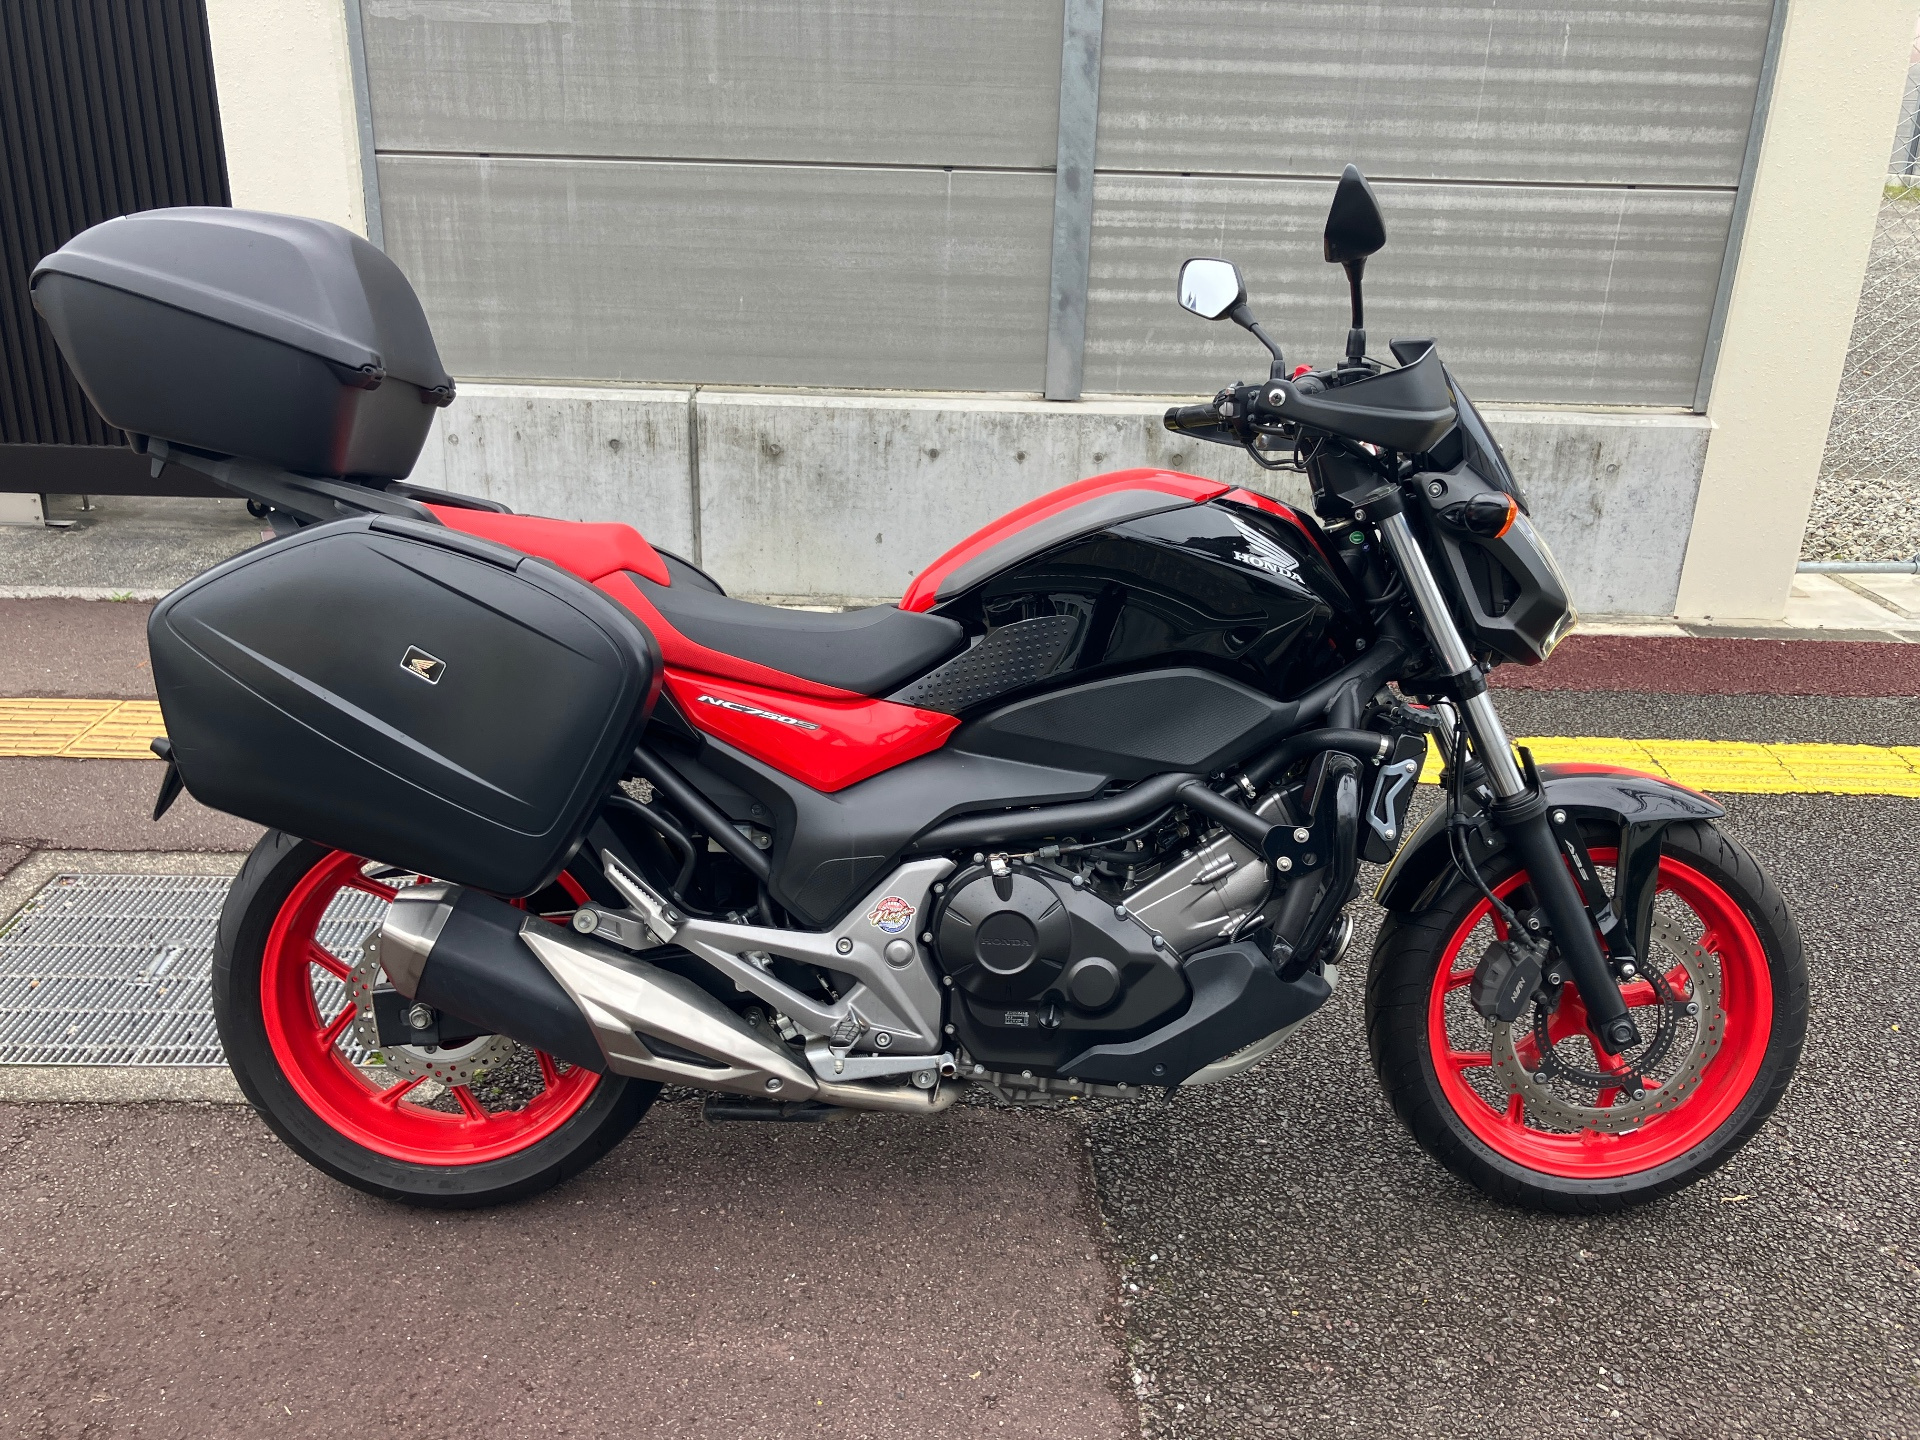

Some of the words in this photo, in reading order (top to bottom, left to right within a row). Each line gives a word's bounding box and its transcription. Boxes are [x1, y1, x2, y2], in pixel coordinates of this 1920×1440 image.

[1233, 551, 1306, 585] HONDA
[408, 665, 430, 679] HONDA
[696, 694, 820, 730] NC750S
[1564, 839, 1590, 881] ABS
[980, 937, 1032, 947] HONDA
